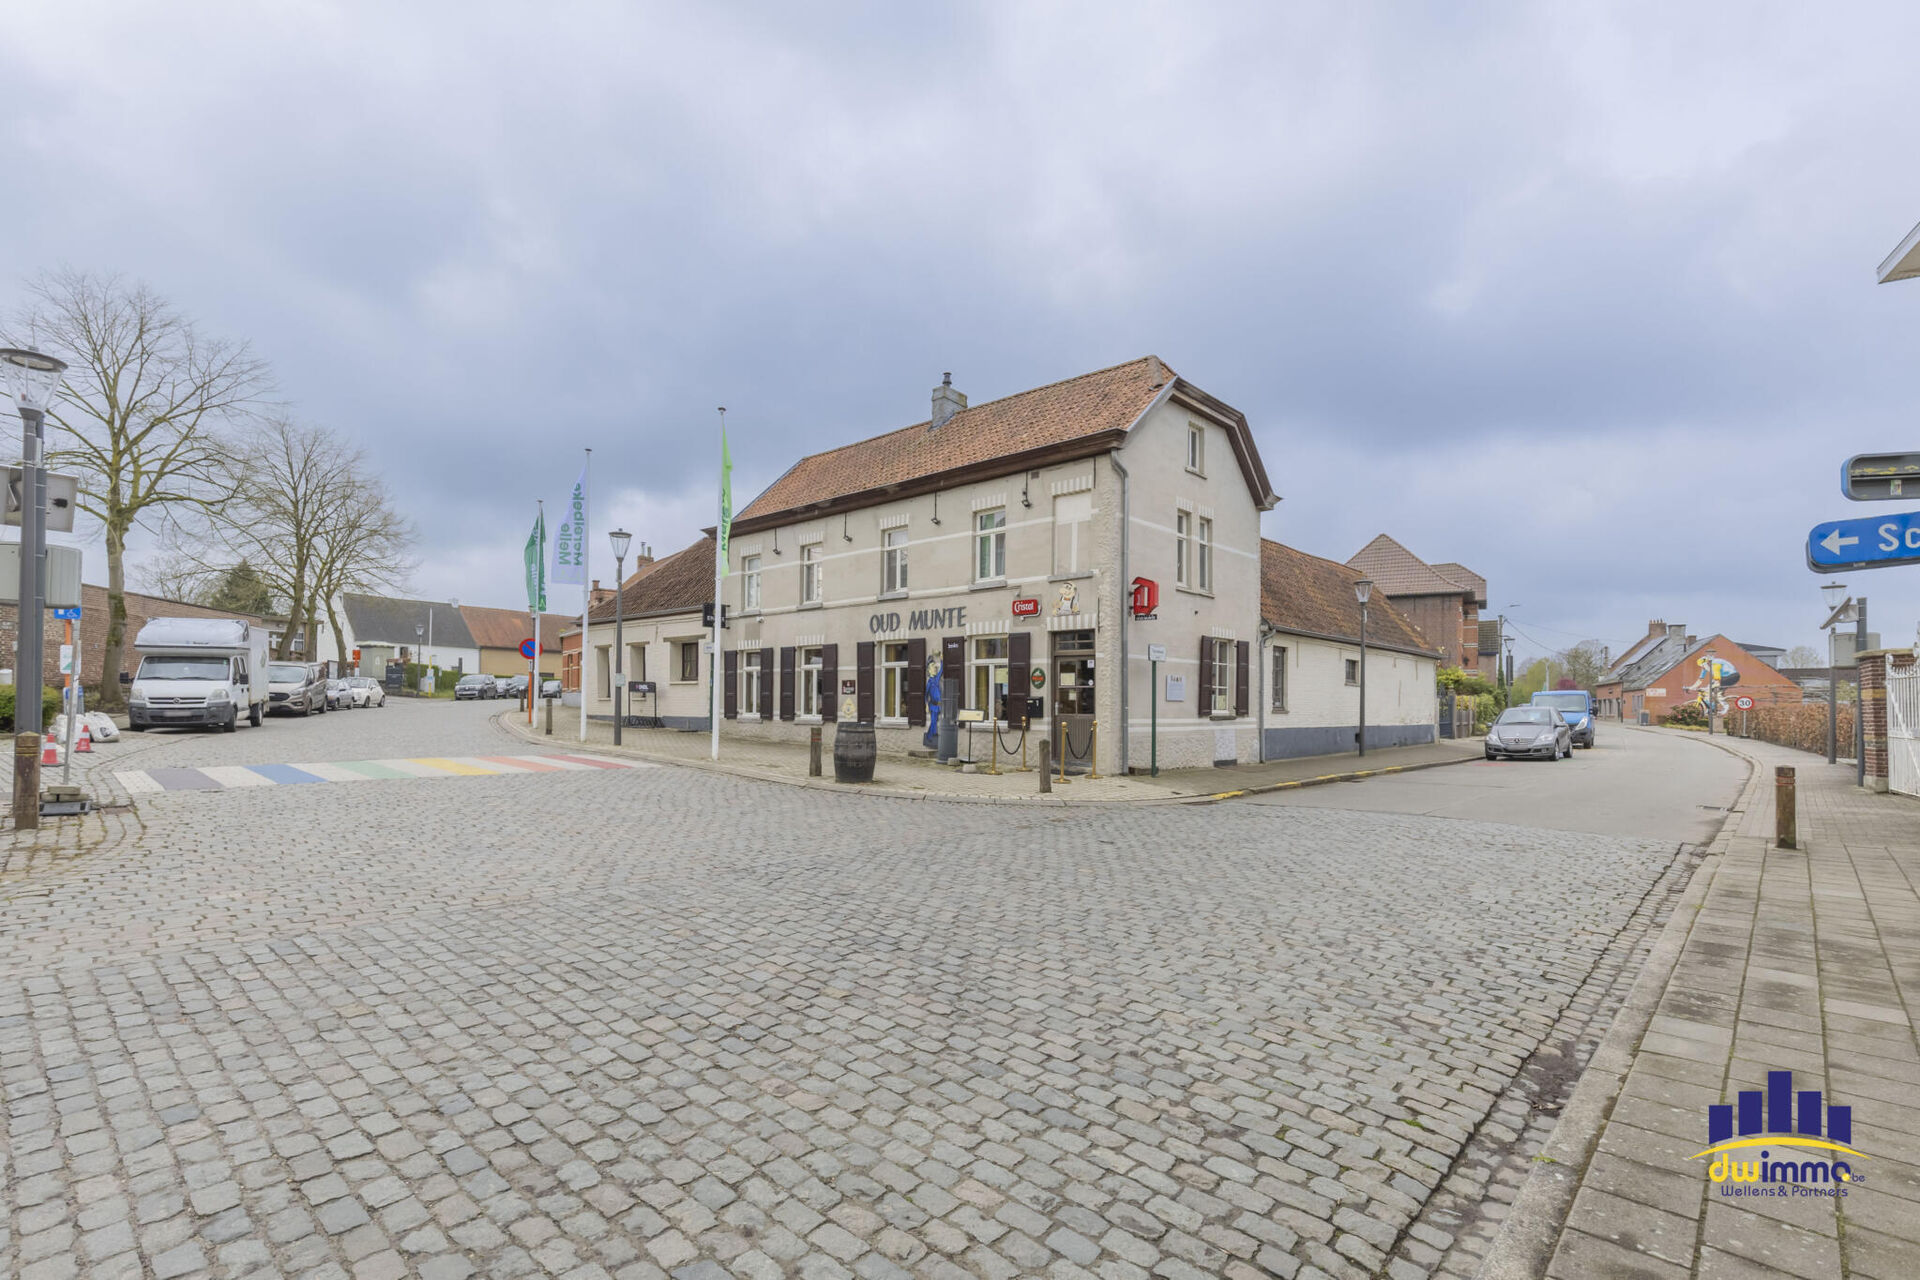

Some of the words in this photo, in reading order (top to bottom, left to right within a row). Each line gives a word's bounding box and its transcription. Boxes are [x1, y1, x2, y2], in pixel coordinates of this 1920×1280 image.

[1014, 601, 1035, 613] Cristal
[869, 612, 901, 633] OUD
[908, 606, 967, 631] MUNTE
[1739, 699, 1751, 707] 30
